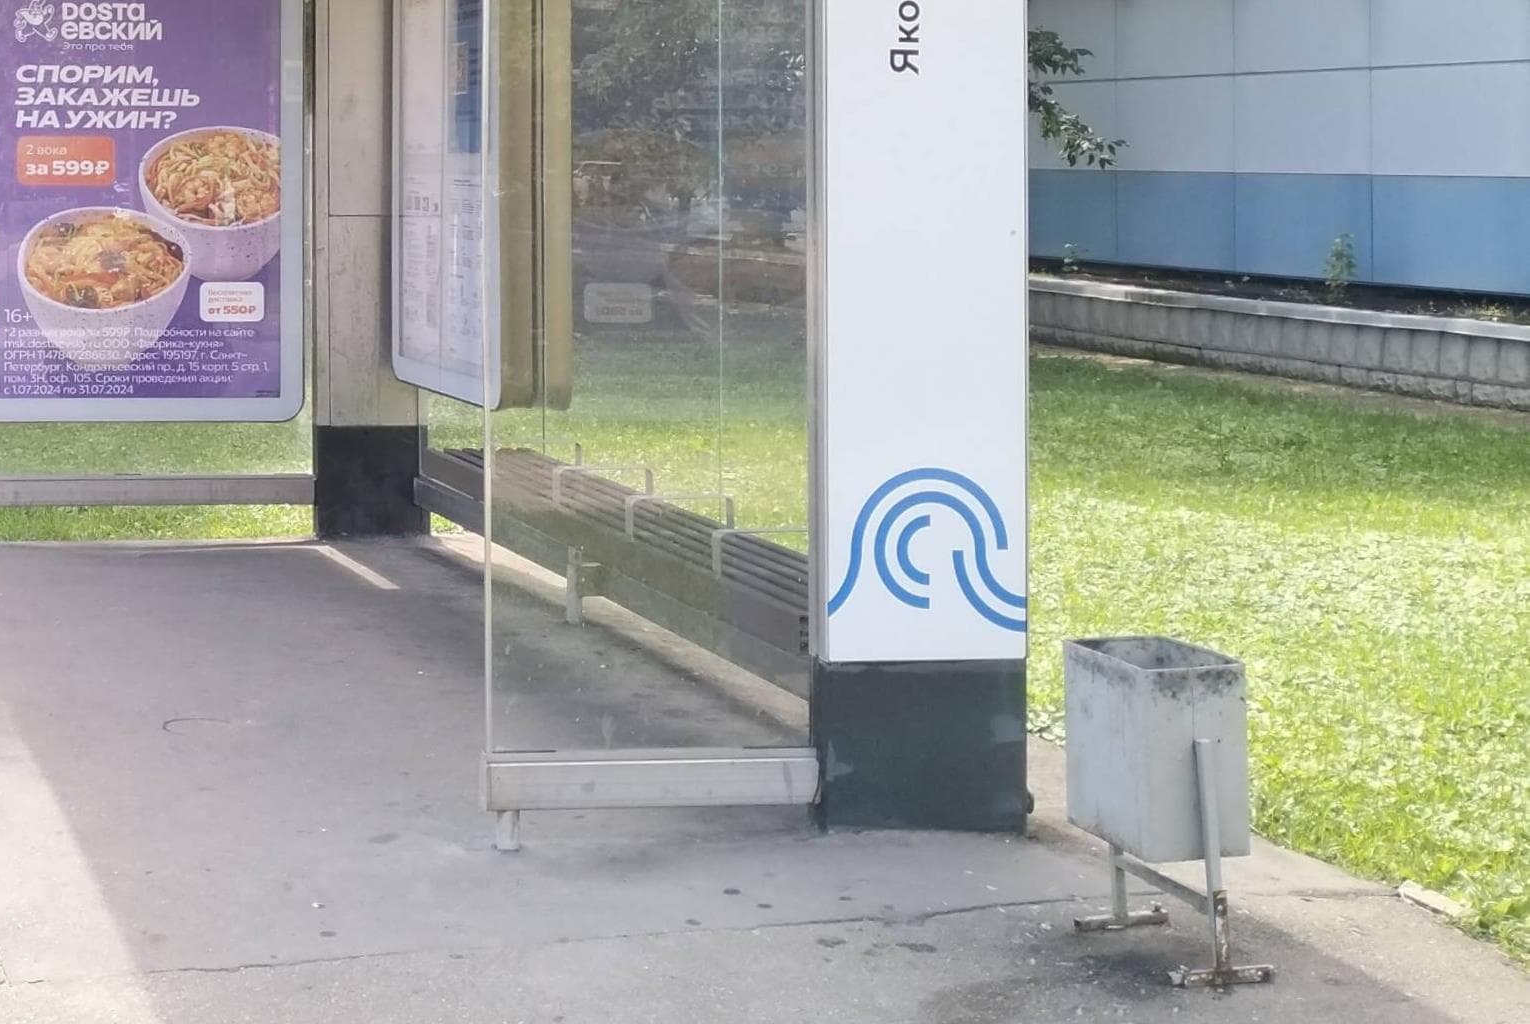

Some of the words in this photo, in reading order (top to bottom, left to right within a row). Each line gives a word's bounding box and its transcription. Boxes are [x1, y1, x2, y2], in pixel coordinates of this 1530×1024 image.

[63, 41, 83, 50] Это
[85, 43, 106, 52] про
[109, 41, 134, 51] тебя
[15, 64, 159, 87] СПОРИМ,
[14, 86, 201, 107] ЗАКАЖЕШЬ
[15, 109, 61, 128] НА
[63, 110, 178, 129] УЖИН?
[26, 144, 35, 155] 2
[37, 146, 68, 156] вока
[25, 163, 49, 176] за
[4, 308, 32, 324] 16+
[208, 307, 221, 315] от
[134, 327, 207, 339] Подробности
[209, 329, 222, 337] на
[223, 327, 255, 337] сайте
[4, 350, 36, 360] ОГРН
[188, 362, 200, 371] 15
[231, 362, 239, 371] 5
[94, 373, 130, 385] Сроки
[63, 386, 77, 394] по
